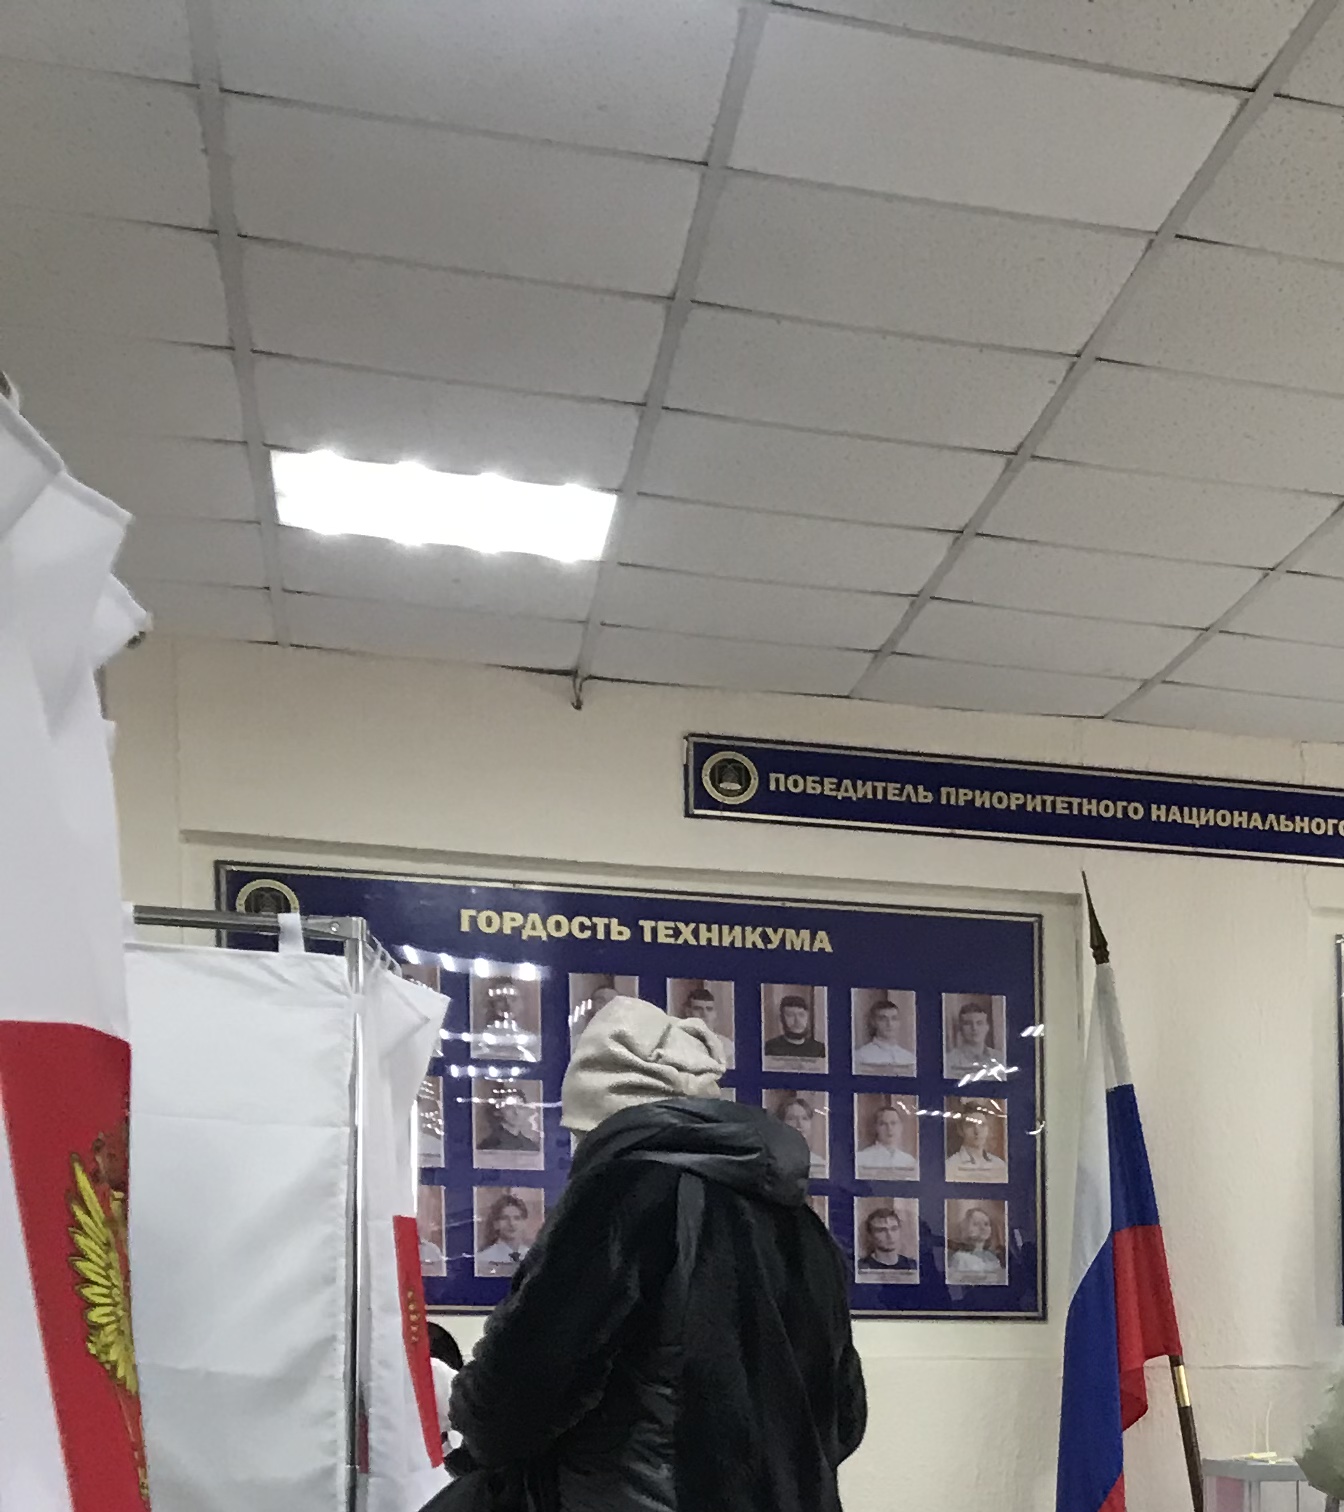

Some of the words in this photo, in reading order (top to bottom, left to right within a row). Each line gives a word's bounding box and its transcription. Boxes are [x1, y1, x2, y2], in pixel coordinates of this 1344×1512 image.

[768, 772, 933, 804] ПОБЕДИТЕЛЬ
[940, 786, 1144, 822] ПРИОРИТЕТНОГО
[460, 908, 632, 941] ГОРДОСТЬ
[639, 919, 833, 952] ТЕХНИКУМА
